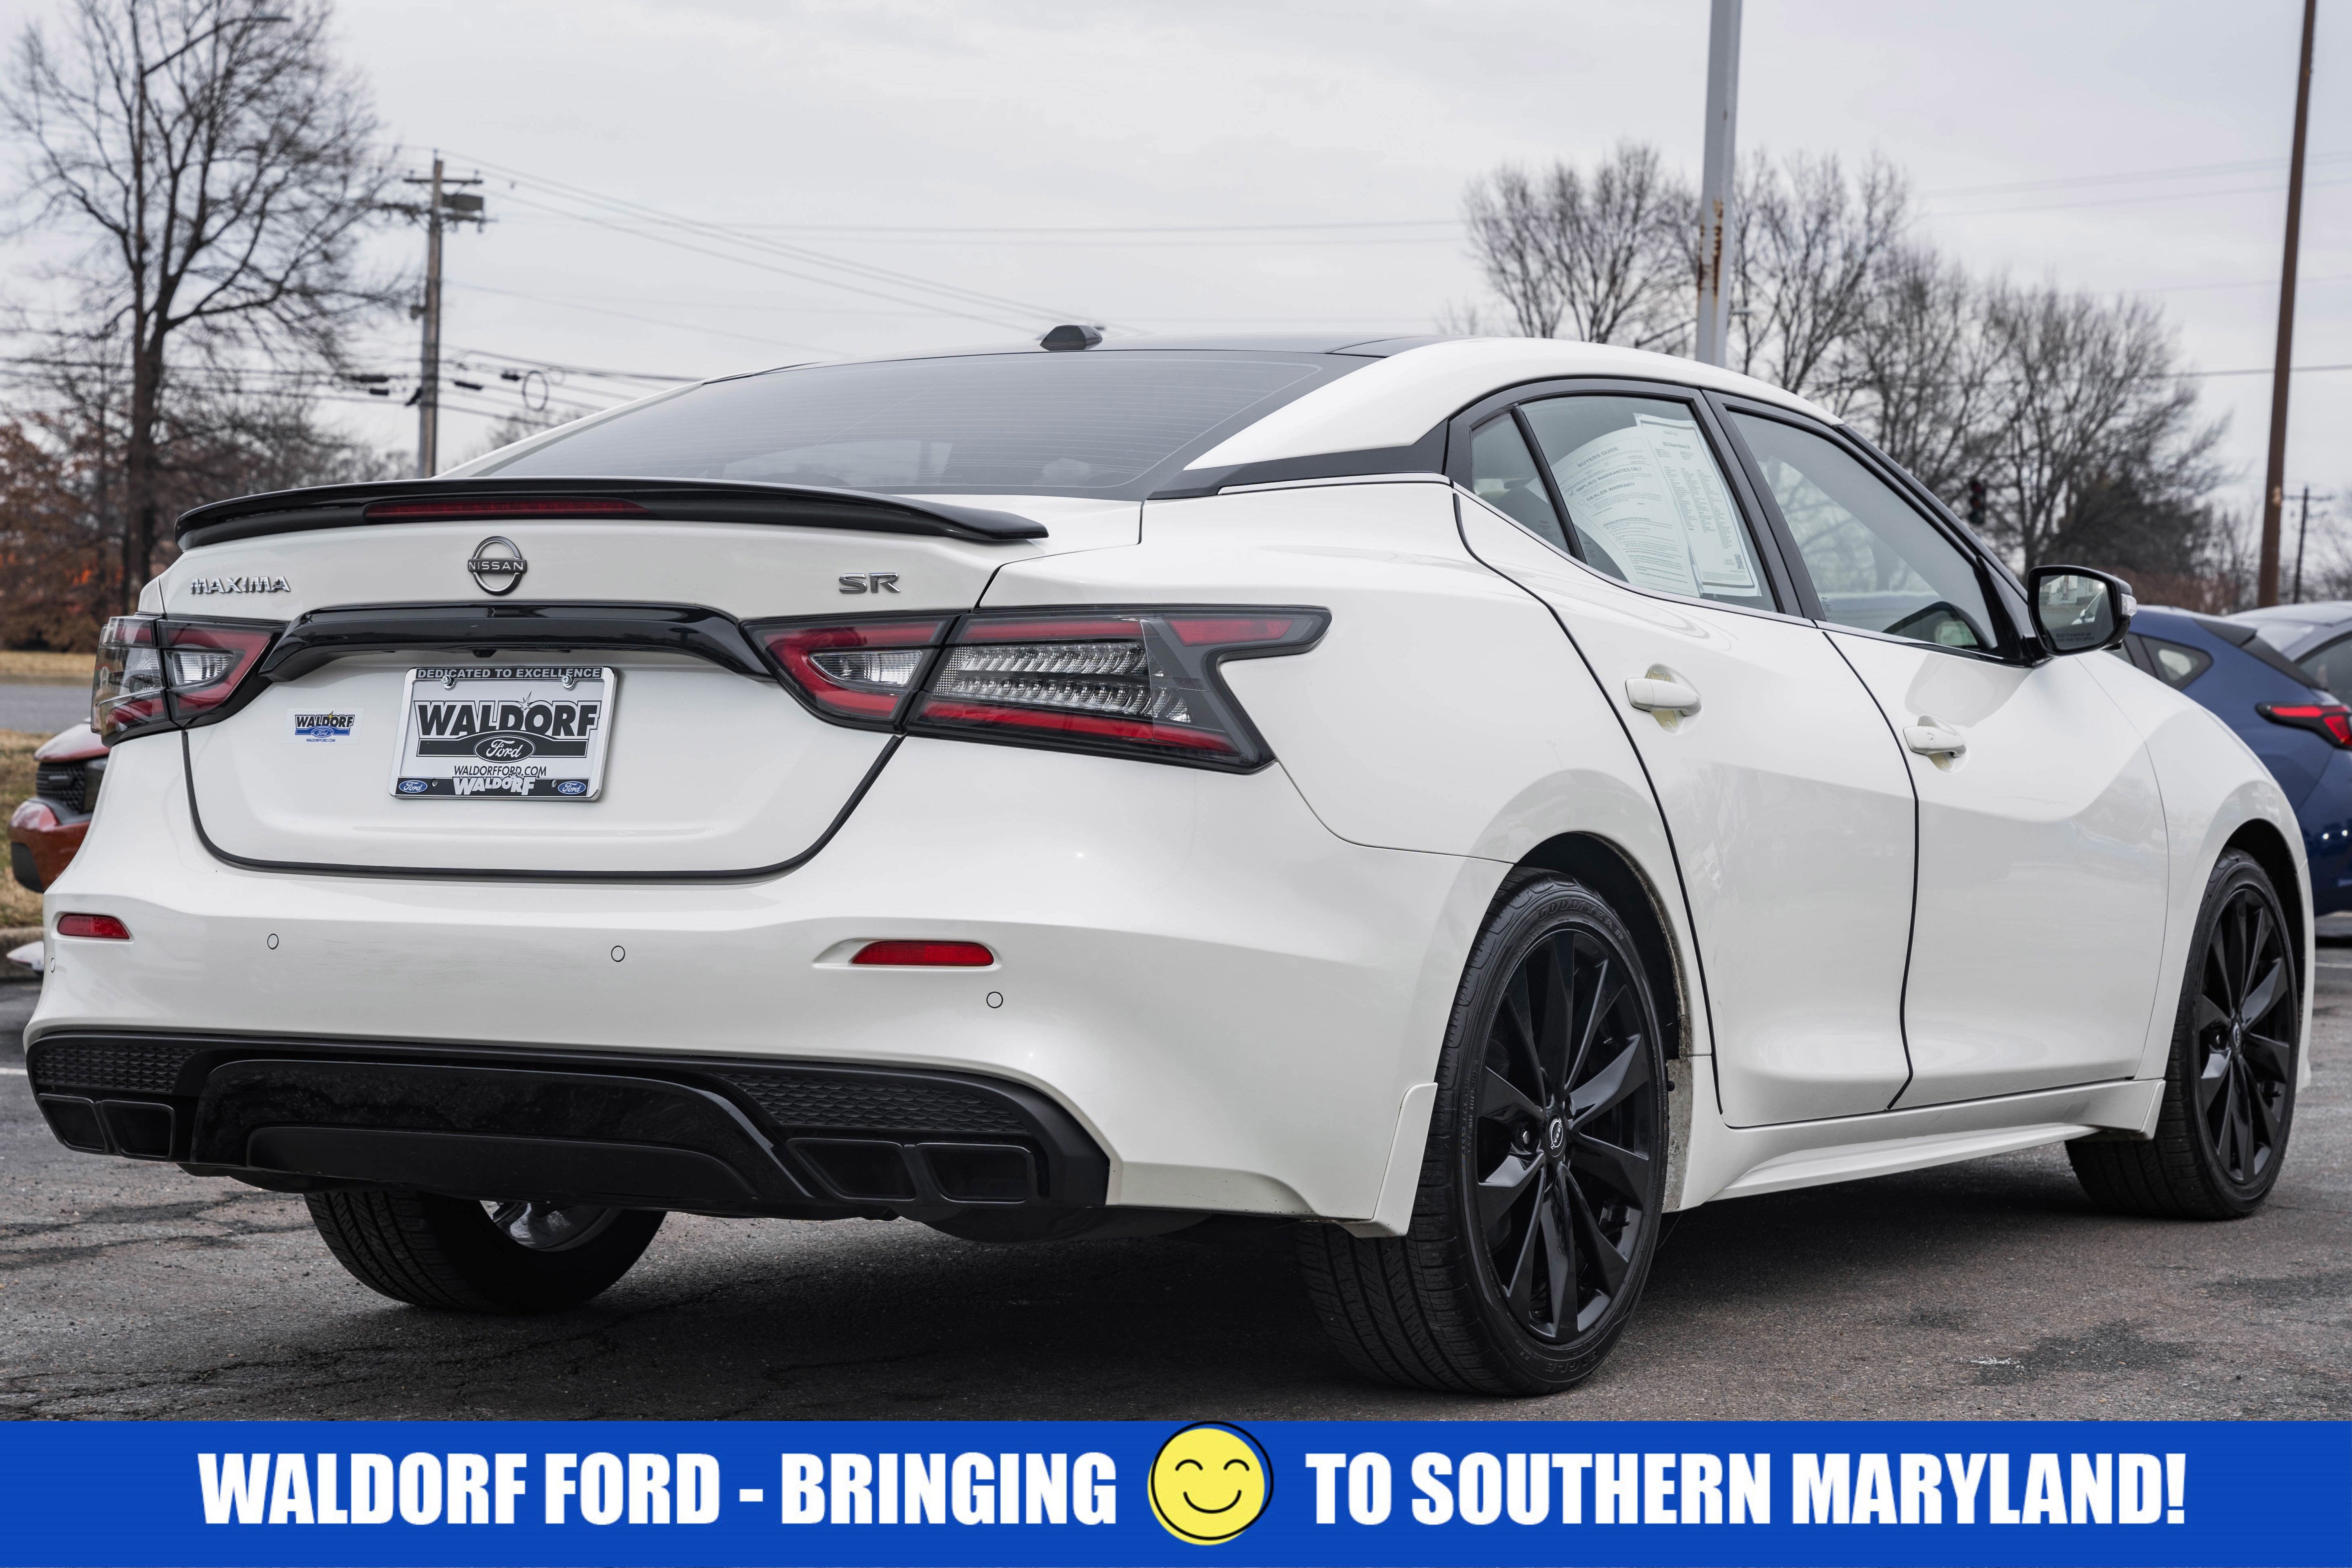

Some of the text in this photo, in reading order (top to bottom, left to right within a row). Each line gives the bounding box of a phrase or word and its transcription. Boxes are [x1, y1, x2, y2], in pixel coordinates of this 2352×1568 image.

[1577, 447, 1619, 468] BUYERS GUIDE
[1576, 479, 1597, 492] IMPLIED
[1597, 468, 1630, 480] WARRANTIES
[1586, 490, 1608, 501] DEALER
[1608, 482, 1635, 491] WARRANTY
[469, 561, 523, 570] NISSAN
[190, 576, 291, 595] MAXIMA
[839, 572, 901, 594] SR
[418, 668, 600, 678] DEDICATED TO EXCELLENCE
[296, 716, 353, 728] WALDORF
[417, 704, 598, 736] WALDORF
[486, 739, 521, 758] Ford
[454, 766, 547, 776] WALDORFFORD.COM
[403, 782, 423, 791] Ford
[453, 776, 536, 795] WALDORF
[562, 783, 582, 792] Ford
[1539, 900, 1624, 940] GOODYEAR
[1551, 1118, 1561, 1149] NISSAN
[1545, 1350, 1598, 1372] EAGLE
